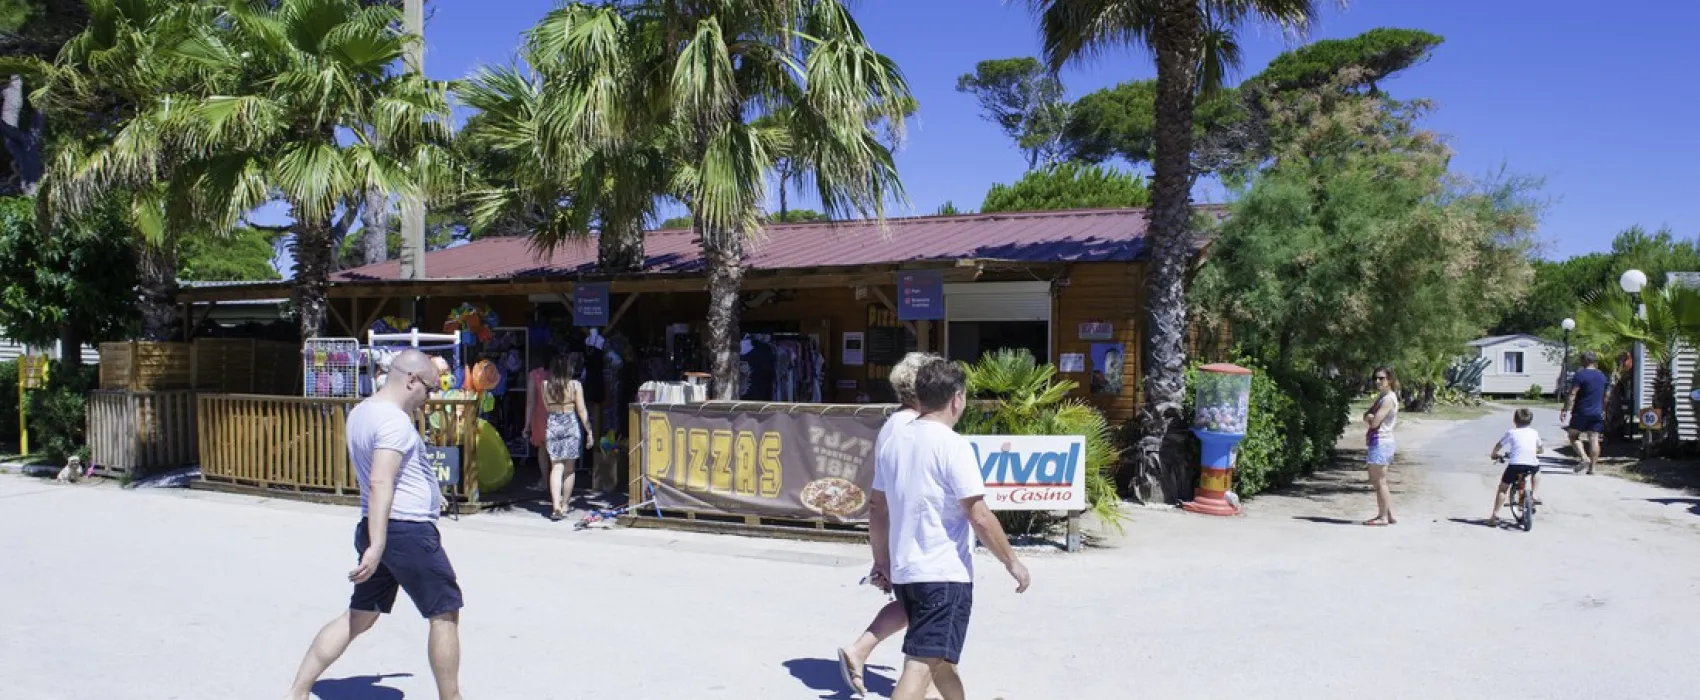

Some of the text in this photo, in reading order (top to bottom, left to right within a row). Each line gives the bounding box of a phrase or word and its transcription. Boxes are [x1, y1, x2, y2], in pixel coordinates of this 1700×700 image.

[646, 411, 783, 498] PIZZAS
[996, 487, 1073, 504] by Casino
